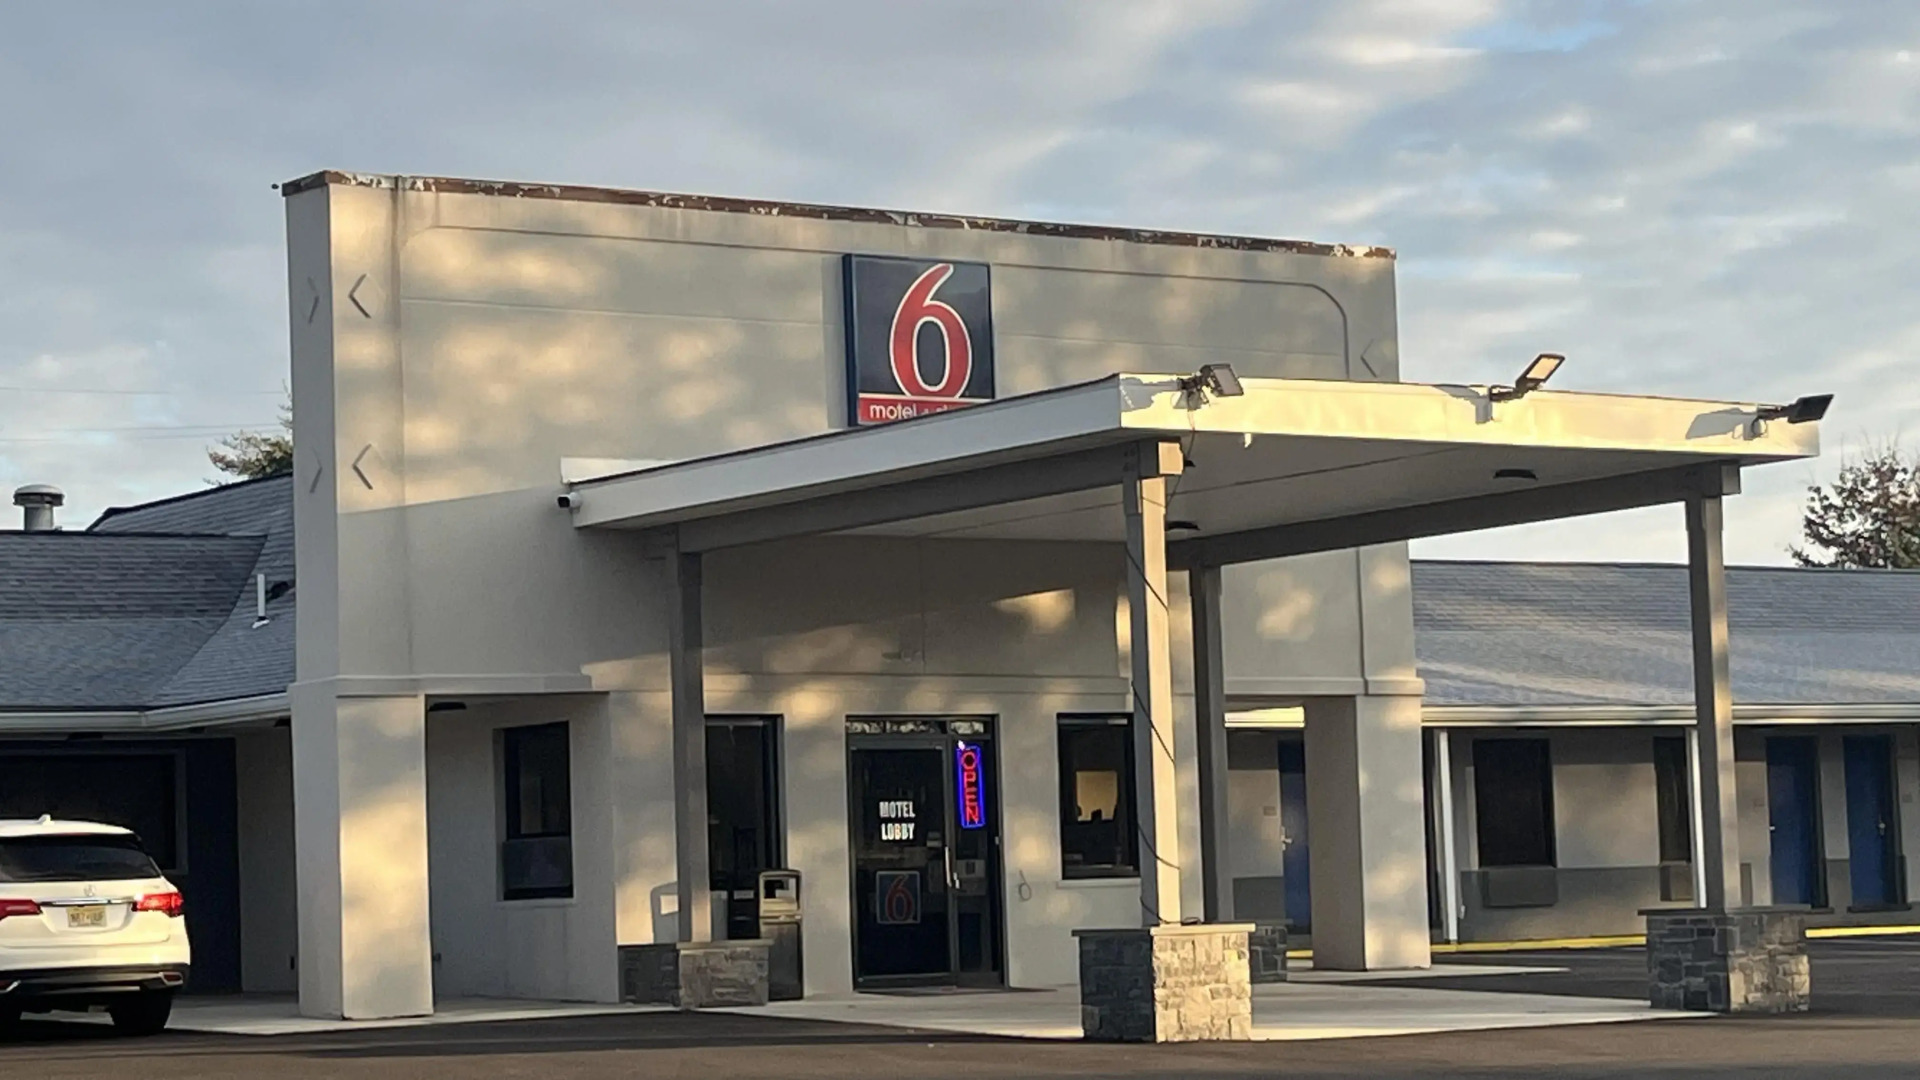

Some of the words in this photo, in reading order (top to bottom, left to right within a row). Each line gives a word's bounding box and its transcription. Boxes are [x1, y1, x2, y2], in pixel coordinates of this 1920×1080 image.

[889, 263, 972, 398] 6
[869, 403, 917, 419] motel
[961, 751, 979, 824] OPEN
[879, 801, 916, 818] MOTEL
[881, 823, 915, 840] LOBBY
[885, 874, 915, 921] 6
